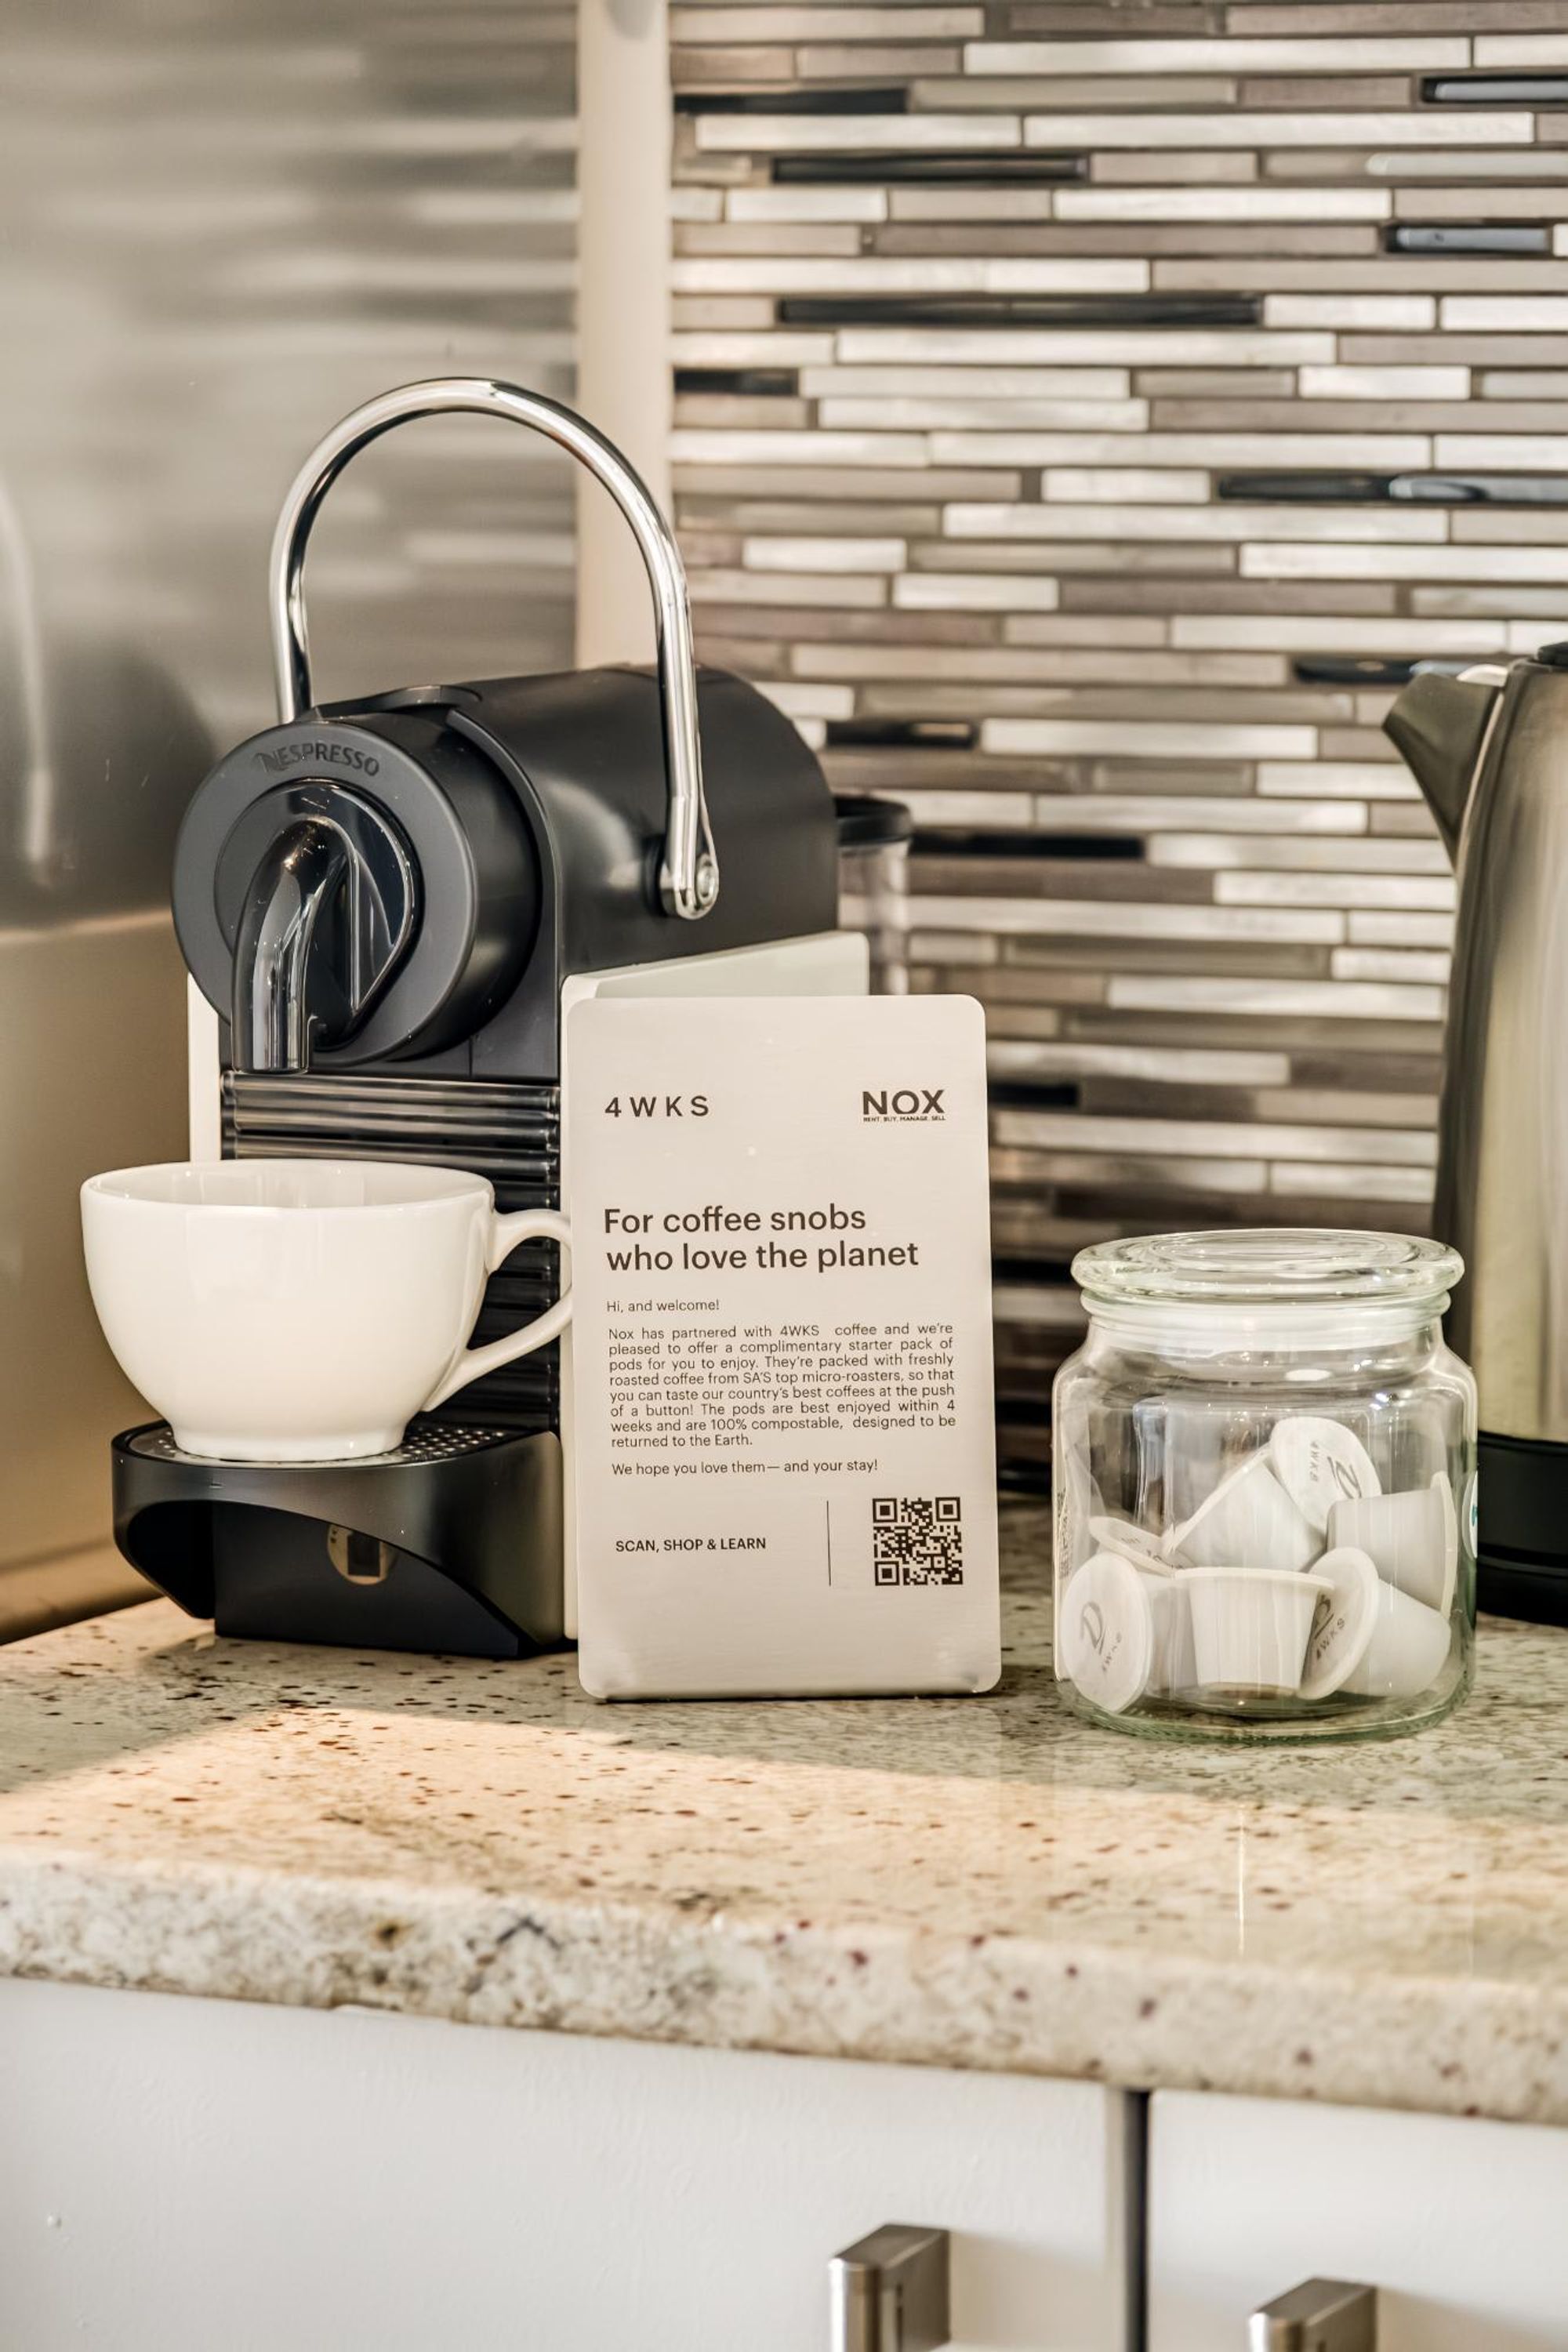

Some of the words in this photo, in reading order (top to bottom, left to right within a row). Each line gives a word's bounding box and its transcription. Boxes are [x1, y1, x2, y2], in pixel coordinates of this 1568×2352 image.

[252, 742, 379, 776] NESPRESSO
[862, 1090, 945, 1115] NOX
[605, 1209, 653, 1233] For
[663, 1206, 760, 1232] coffee
[771, 1203, 866, 1231] snobs
[607, 1244, 673, 1270] who
[684, 1243, 746, 1269] love
[756, 1242, 807, 1268] the
[818, 1240, 918, 1272] planet
[607, 1301, 623, 1313] Hi,
[628, 1300, 652, 1312] and
[656, 1299, 719, 1311] welcome!
[609, 1328, 634, 1340] Nox
[642, 1327, 664, 1340] has
[672, 1326, 736, 1341] partnered
[744, 1325, 771, 1337] with
[780, 1325, 819, 1337] 4WKS
[835, 1323, 877, 1335] coffee
[884, 1323, 909, 1334] and
[917, 1323, 953, 1334] we're
[609, 1342, 660, 1356] pleased
[668, 1344, 681, 1354] to
[688, 1341, 718, 1353] offer
[725, 1345, 732, 1353] a
[740, 1341, 841, 1356] complimentary
[849, 1341, 892, 1351] starter
[901, 1338, 932, 1353] pack
[940, 1338, 953, 1349] of
[609, 1358, 642, 1372] pods
[648, 1358, 666, 1370] for
[672, 1360, 695, 1372] you
[701, 1359, 714, 1369] to
[720, 1356, 758, 1371] enjoy.
[764, 1356, 813, 1370] They're
[819, 1355, 868, 1370] packed
[874, 1354, 902, 1366] with
[909, 1353, 953, 1369] freshly
[610, 1373, 659, 1385] roasted
[663, 1373, 704, 1385] coffee
[708, 1372, 739, 1384] from
[743, 1371, 771, 1384] SA'S
[775, 1373, 798, 1386] top
[802, 1370, 904, 1384] micro-roasters,
[908, 1371, 924, 1381] so
[927, 1369, 954, 1381] that
[610, 1392, 633, 1403] you
[638, 1392, 662, 1401] can
[666, 1390, 699, 1400] taste
[702, 1390, 724, 1400] our
[728, 1387, 789, 1402] country's
[793, 1386, 822, 1398] best
[826, 1385, 875, 1397] coffees
[880, 1386, 891, 1396] at
[896, 1385, 917, 1396] the
[923, 1384, 954, 1398] push
[611, 1404, 624, 1417] of
[631, 1406, 638, 1416] a
[646, 1404, 693, 1416] button!
[701, 1403, 725, 1415] The
[733, 1403, 765, 1417] pods
[772, 1405, 793, 1414] are
[800, 1402, 829, 1414] best
[837, 1400, 890, 1416] enjoyed
[898, 1399, 938, 1411] within
[947, 1399, 955, 1410] 4
[611, 1420, 652, 1432] weeks
[656, 1419, 681, 1432] and
[686, 1422, 706, 1431] are
[710, 1418, 747, 1430] 100%
[752, 1417, 843, 1434] compostable,
[853, 1416, 915, 1430] designed
[920, 1417, 934, 1427] to
[938, 1415, 956, 1426] be
[612, 1436, 668, 1447] returned
[672, 1436, 686, 1446] to
[689, 1435, 711, 1446] the
[715, 1434, 753, 1446] Earth.
[612, 1464, 632, 1475] We
[637, 1462, 670, 1477] hope
[673, 1465, 697, 1476] you
[701, 1461, 728, 1473] love
[784, 1460, 808, 1472] and
[813, 1462, 843, 1474] your
[847, 1459, 877, 1473] stay!
[616, 1540, 659, 1553] SCAN,
[663, 1539, 703, 1551] SHOP
[707, 1539, 717, 1550] &
[720, 1537, 766, 1550] LEARN
